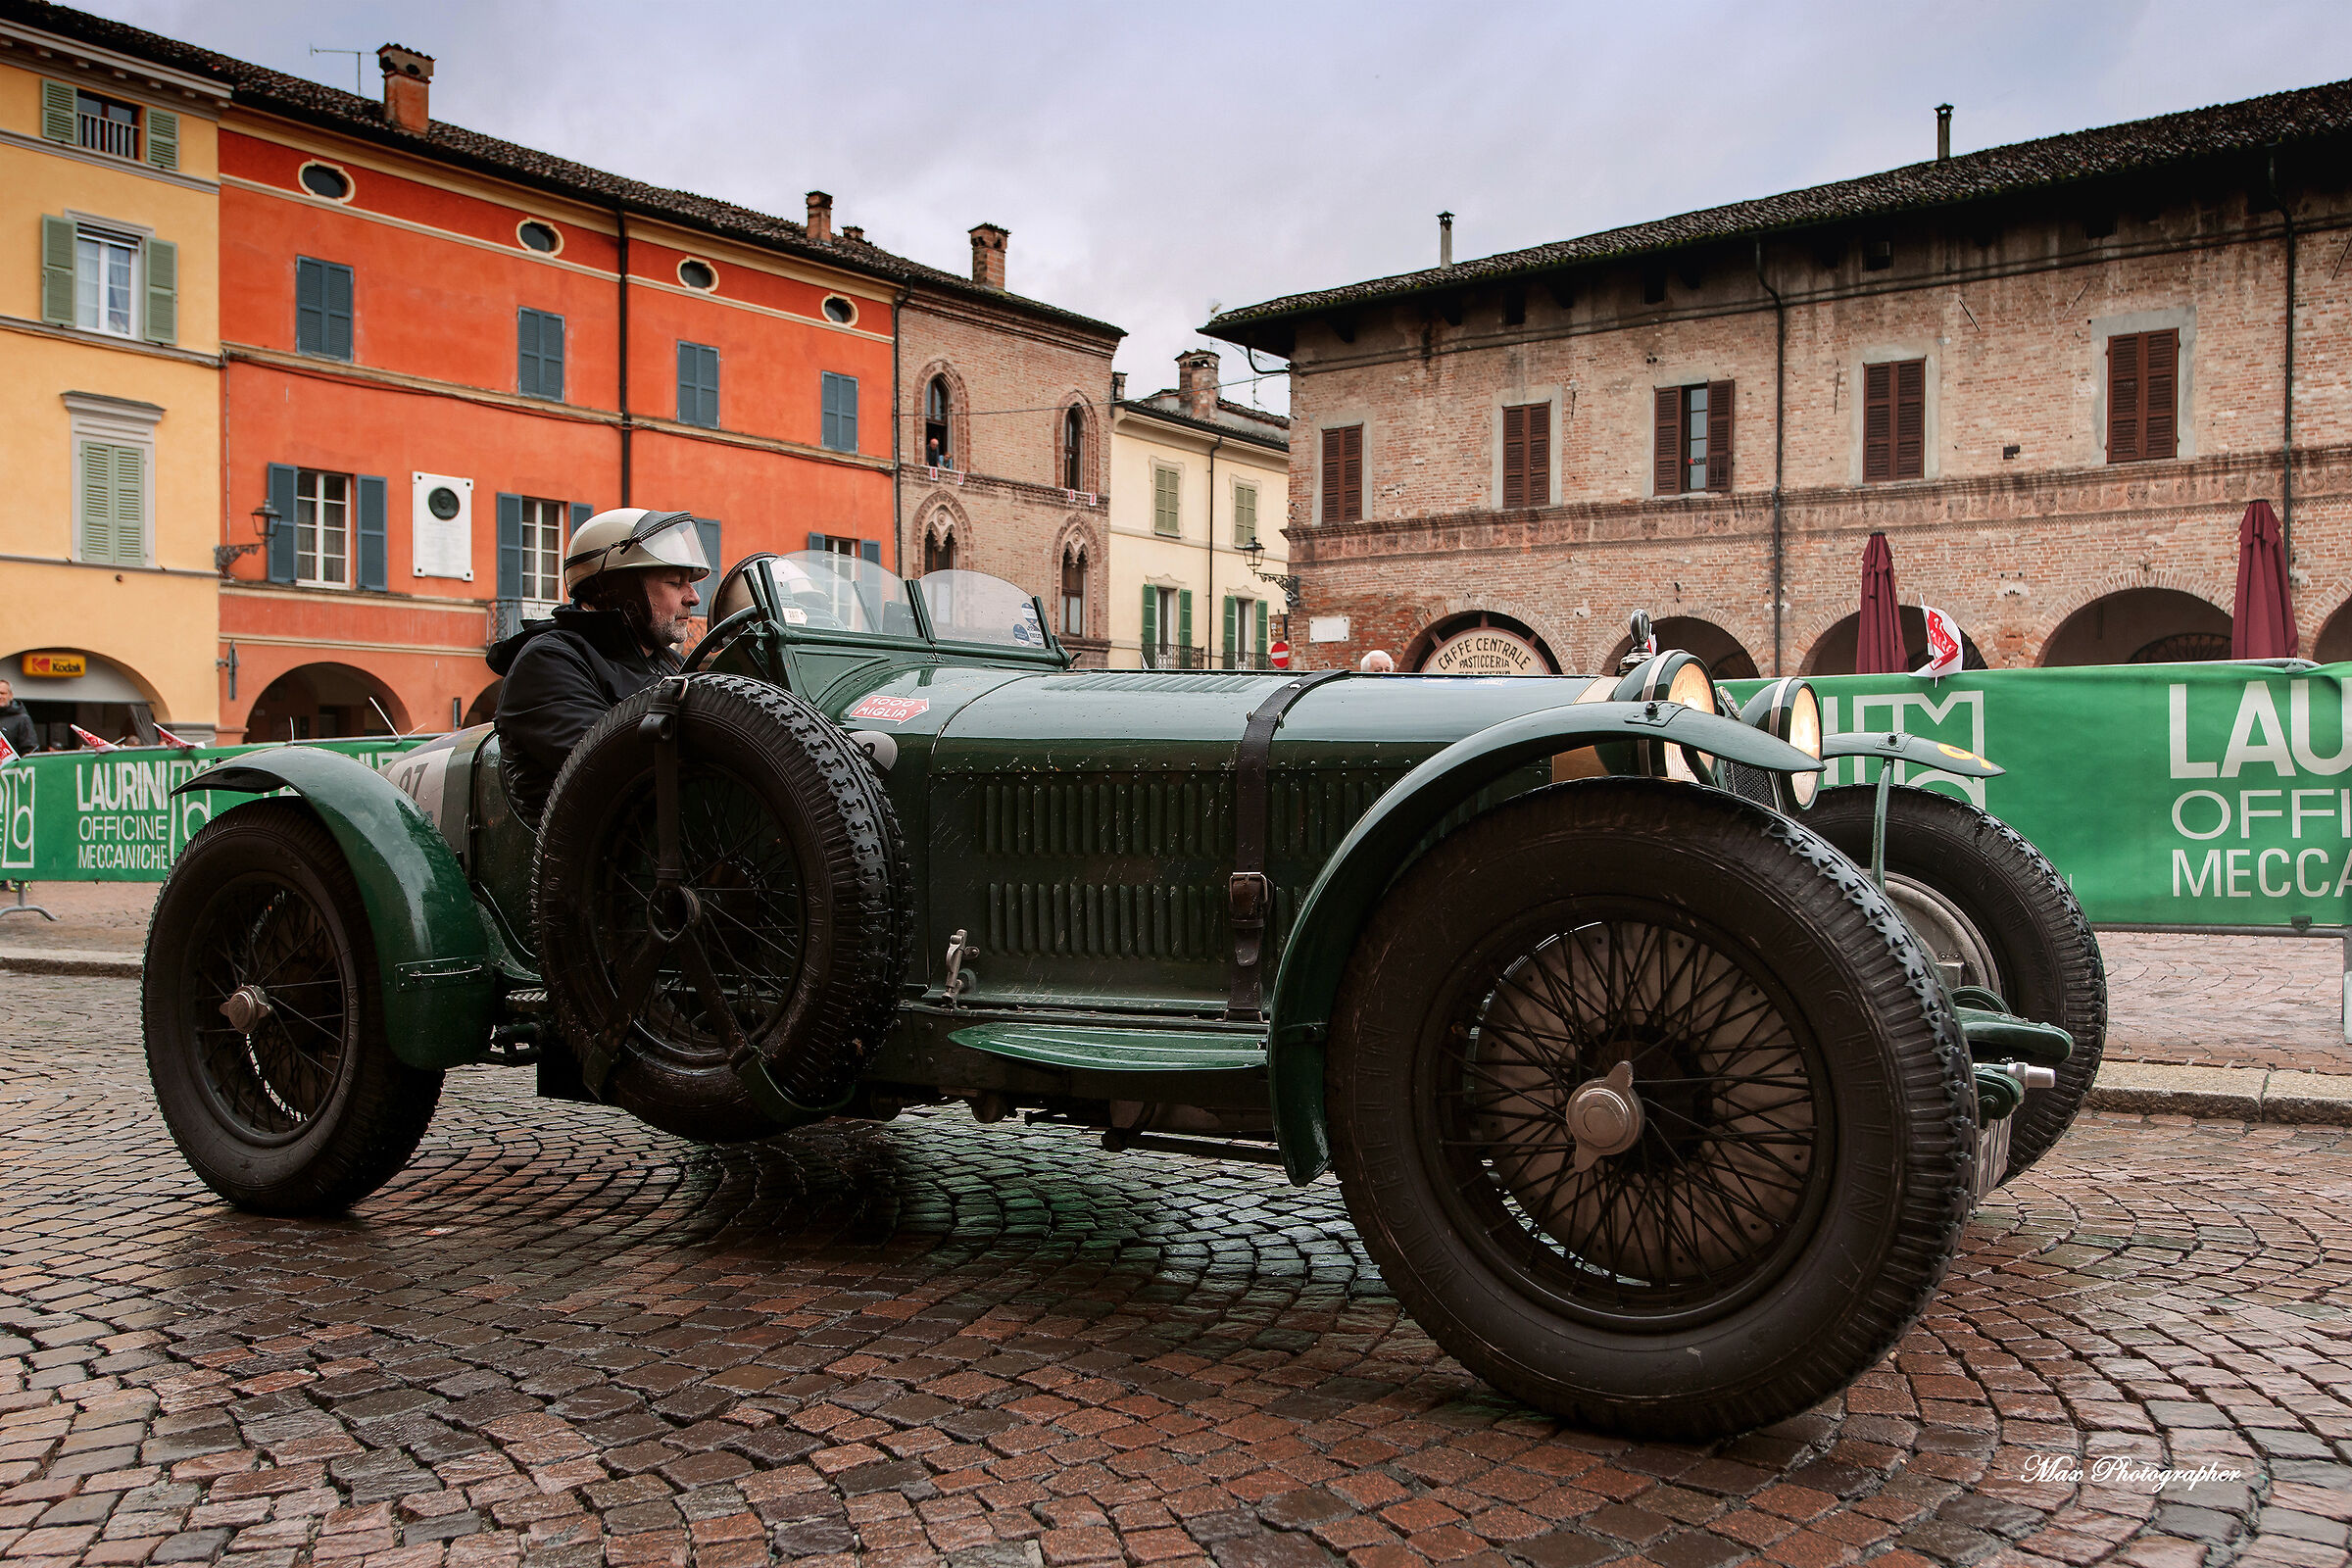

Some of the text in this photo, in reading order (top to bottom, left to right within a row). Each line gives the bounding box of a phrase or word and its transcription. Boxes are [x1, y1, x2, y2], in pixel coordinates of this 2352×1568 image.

[52, 662, 81, 673] Kodak
[1459, 655, 1510, 668] PASTICCERIA
[1476, 638, 1531, 670] CENTRALE
[855, 706, 907, 718] MIGLIA
[871, 697, 915, 708] 1000
[2169, 677, 2352, 779] LAU
[76, 760, 168, 811] LAURINI
[2171, 788, 2351, 841] OFFI
[78, 815, 168, 842] OFFICINE
[78, 844, 168, 869] MECCANICHE
[1771, 919, 1891, 1226] MICHELIN
